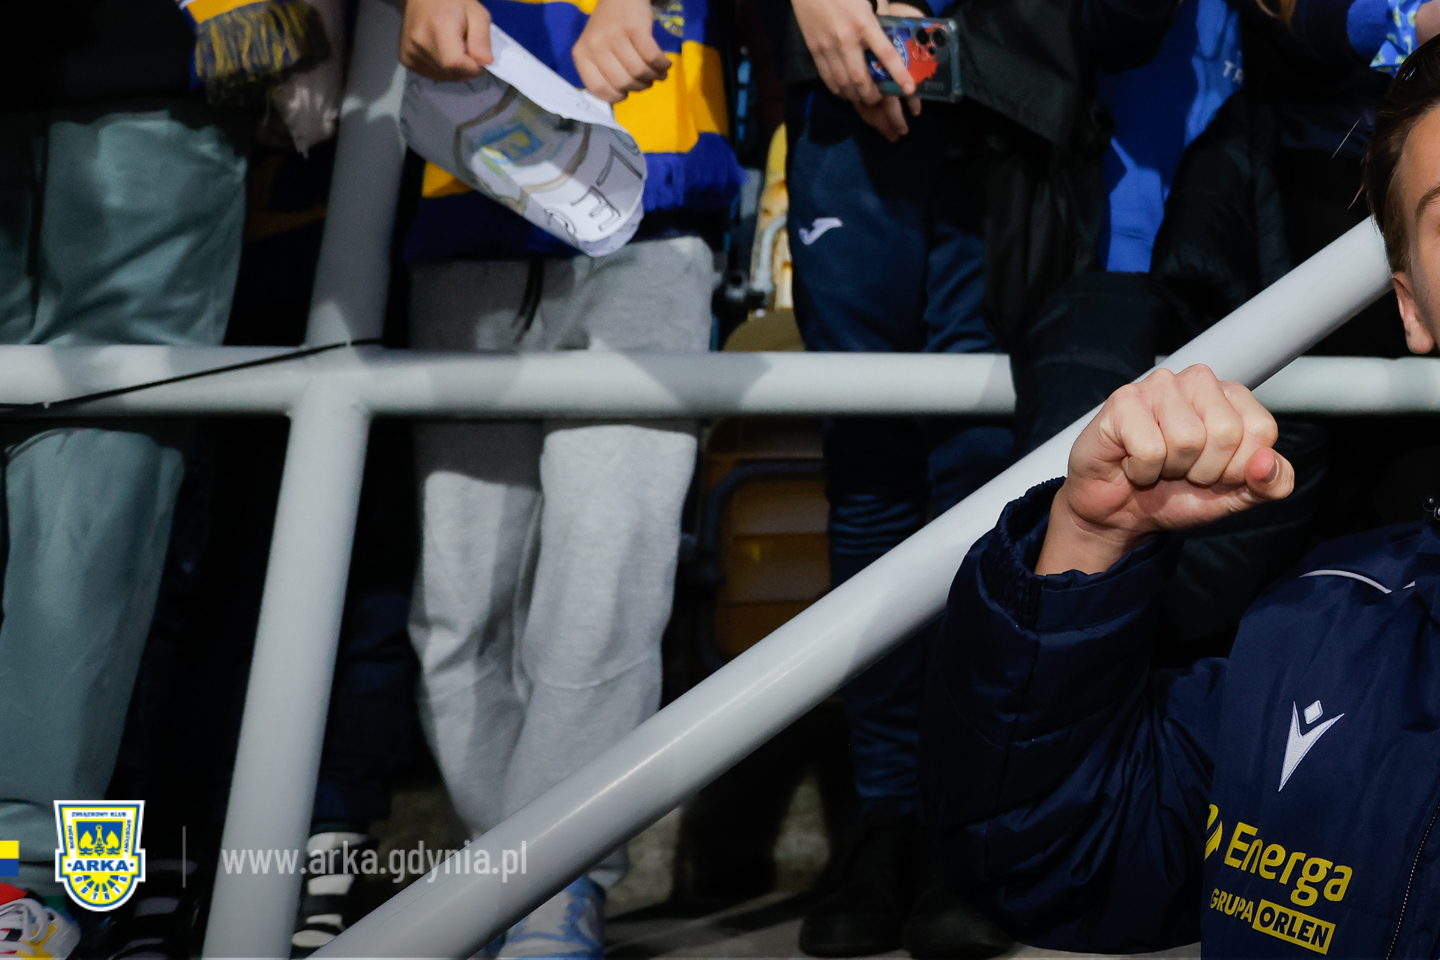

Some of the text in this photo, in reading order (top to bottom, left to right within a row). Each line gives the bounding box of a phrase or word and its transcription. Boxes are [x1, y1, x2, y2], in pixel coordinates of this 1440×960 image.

[1224, 821, 1353, 907] Energa
[1209, 887, 1330, 949] GRUPA ORLEN
